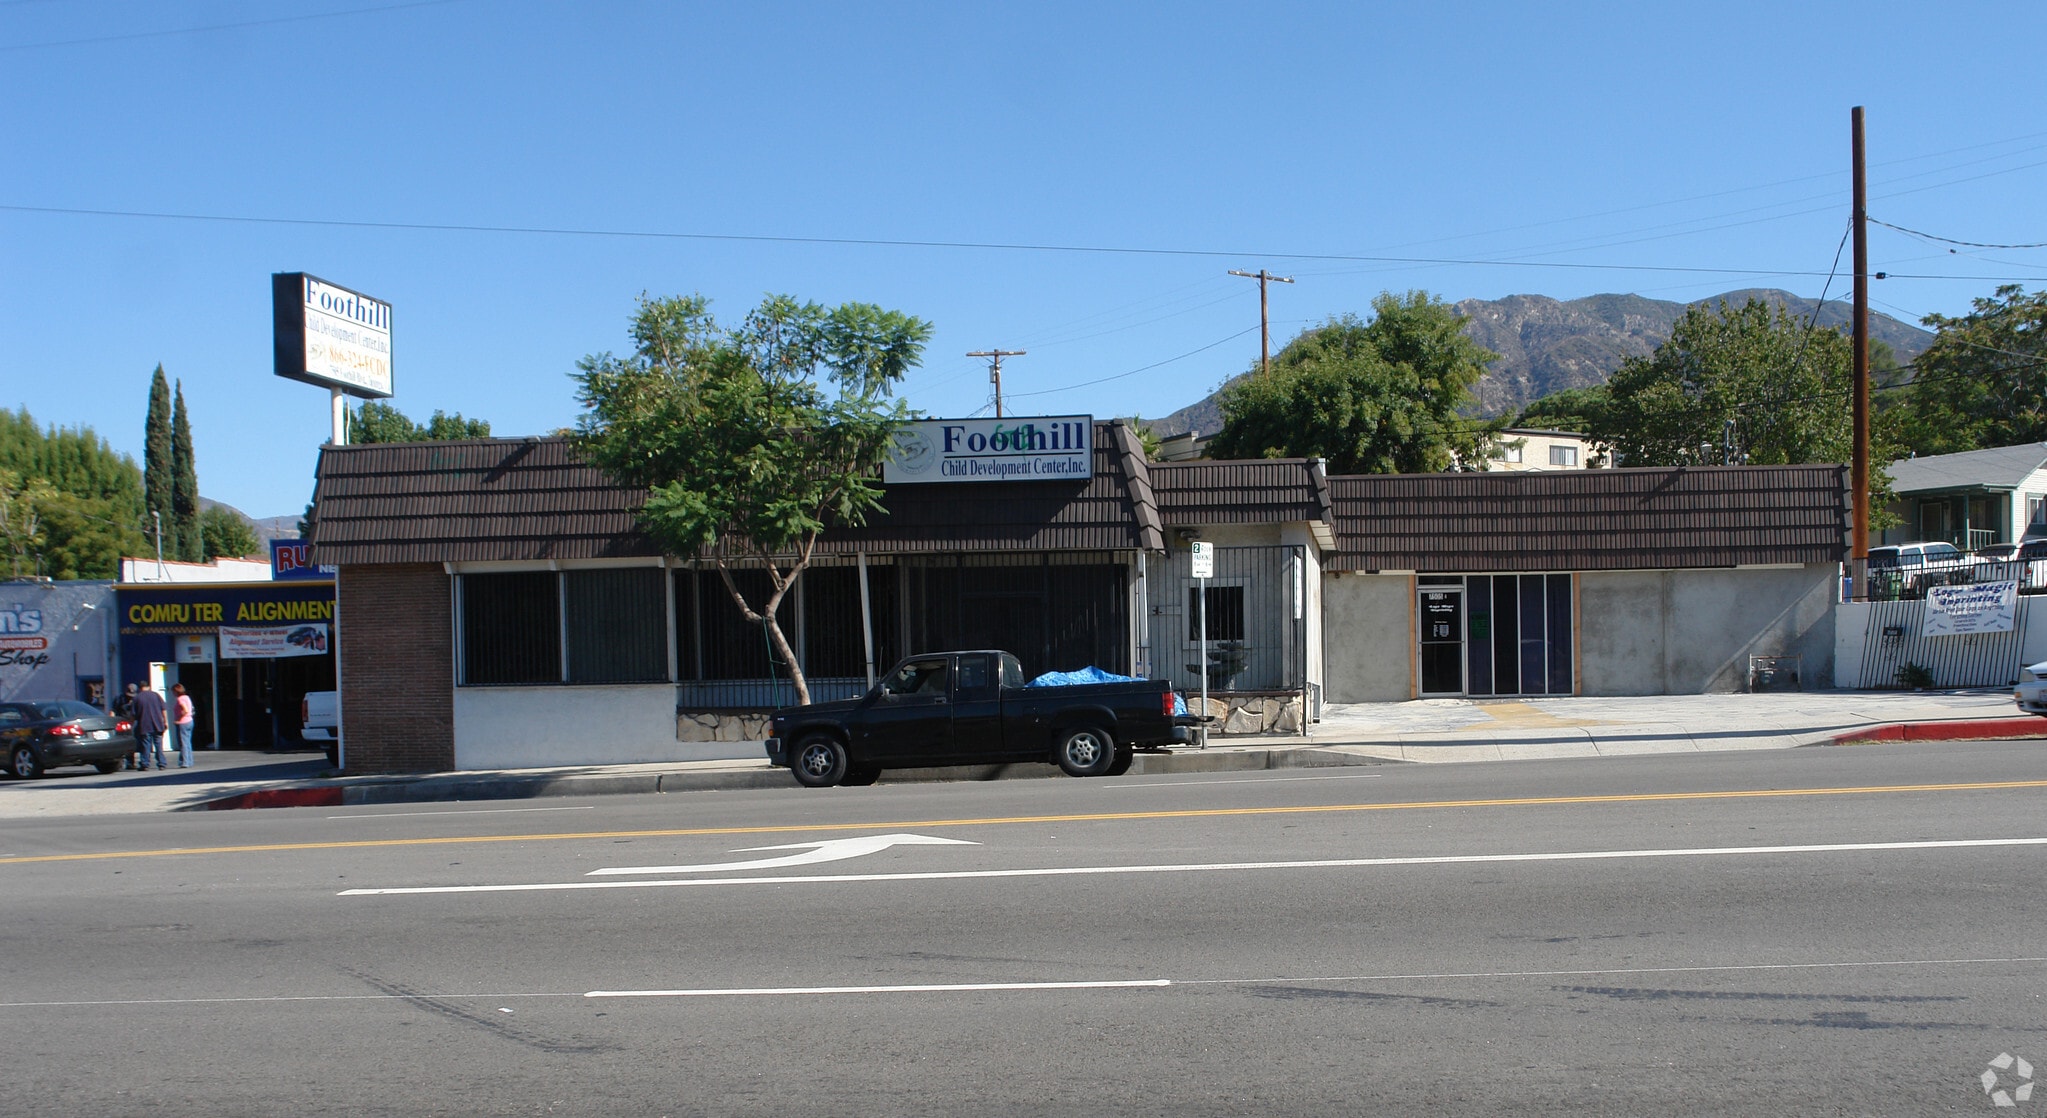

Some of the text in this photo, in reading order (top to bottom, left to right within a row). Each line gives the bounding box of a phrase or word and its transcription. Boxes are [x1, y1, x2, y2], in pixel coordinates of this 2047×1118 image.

[306, 277, 387, 329] Foothill
[321, 317, 356, 344] Development
[942, 422, 1085, 453] Foothill
[941, 459, 967, 477] Child
[970, 460, 1031, 479] Development
[1933, 582, 2014, 597] Logo Magic
[1939, 594, 2003, 606] Imprinting
[0, 649, 49, 670] Shop
